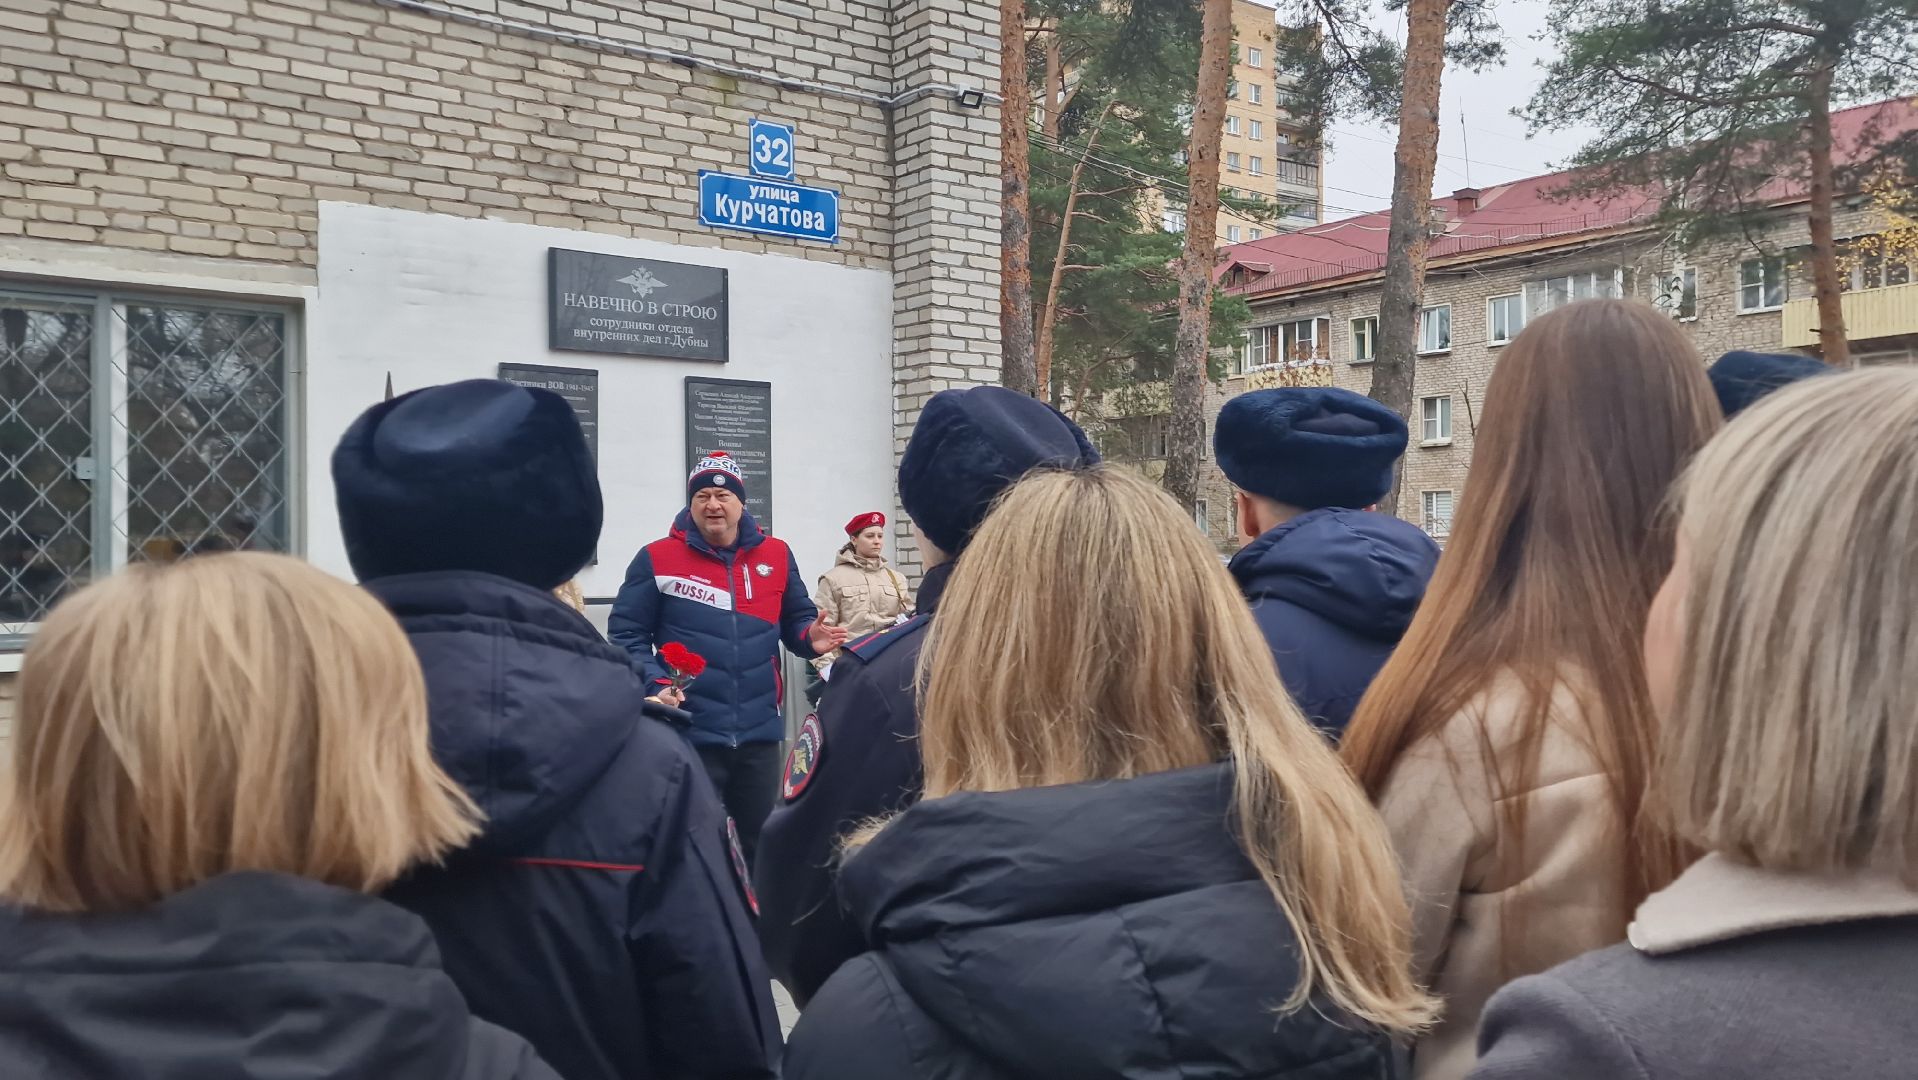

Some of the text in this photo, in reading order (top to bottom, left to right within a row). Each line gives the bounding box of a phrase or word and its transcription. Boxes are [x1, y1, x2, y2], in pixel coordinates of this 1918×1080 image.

[755, 134, 789, 167] 32
[748, 184, 800, 204] улица
[715, 193, 826, 231] Курчатова
[564, 292, 717, 320] НАВЕЧНО В СТРОЮ
[589, 316, 694, 334] сотрудники отдела
[573, 328, 709, 349] внутренних дел г.Дубны
[548, 381, 564, 390] ВОВ
[674, 581, 716, 604] RUSSIA
